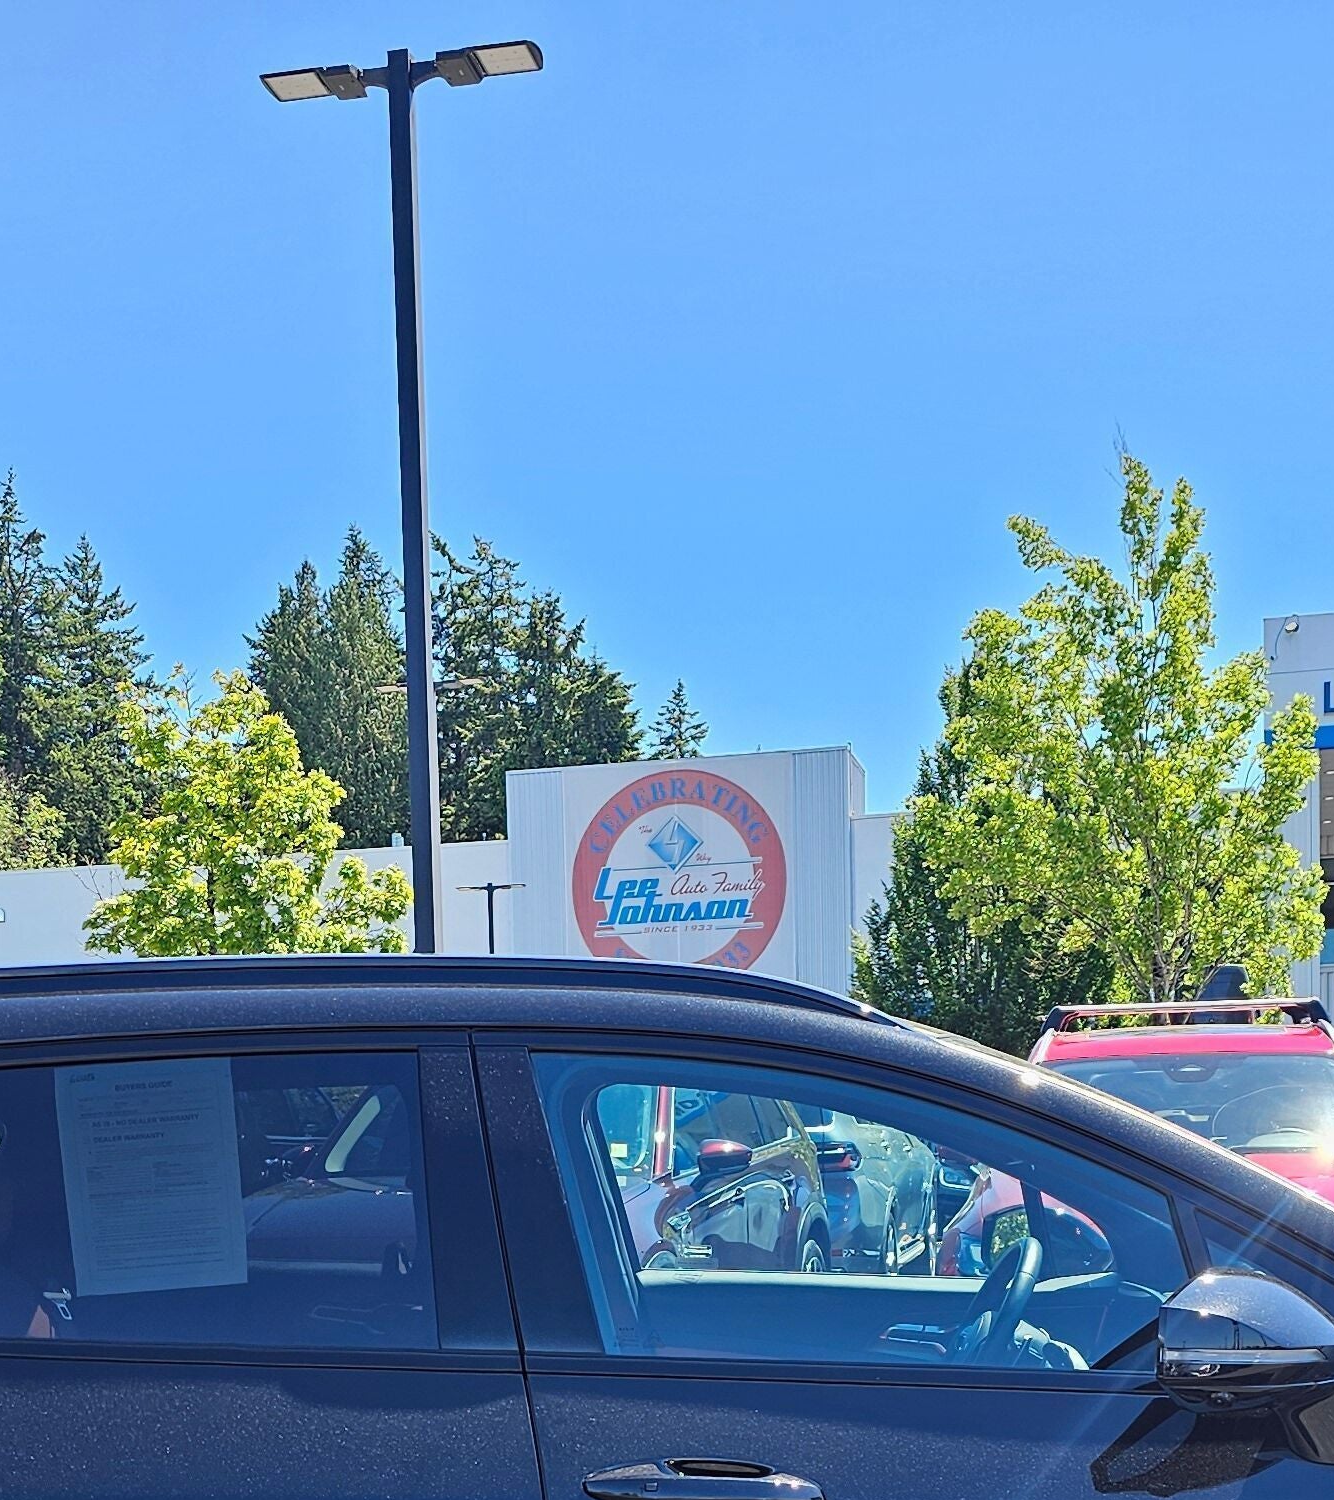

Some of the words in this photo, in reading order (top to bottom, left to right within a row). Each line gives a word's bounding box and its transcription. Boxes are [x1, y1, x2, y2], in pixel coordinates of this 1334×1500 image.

[589, 777, 768, 854] CELEBRATING
[595, 867, 663, 900] Lee
[670, 873, 708, 896] Auto
[712, 869, 766, 901] Family
[598, 894, 753, 926] Johnson
[643, 924, 679, 934] SINCE
[683, 923, 713, 932] 1933
